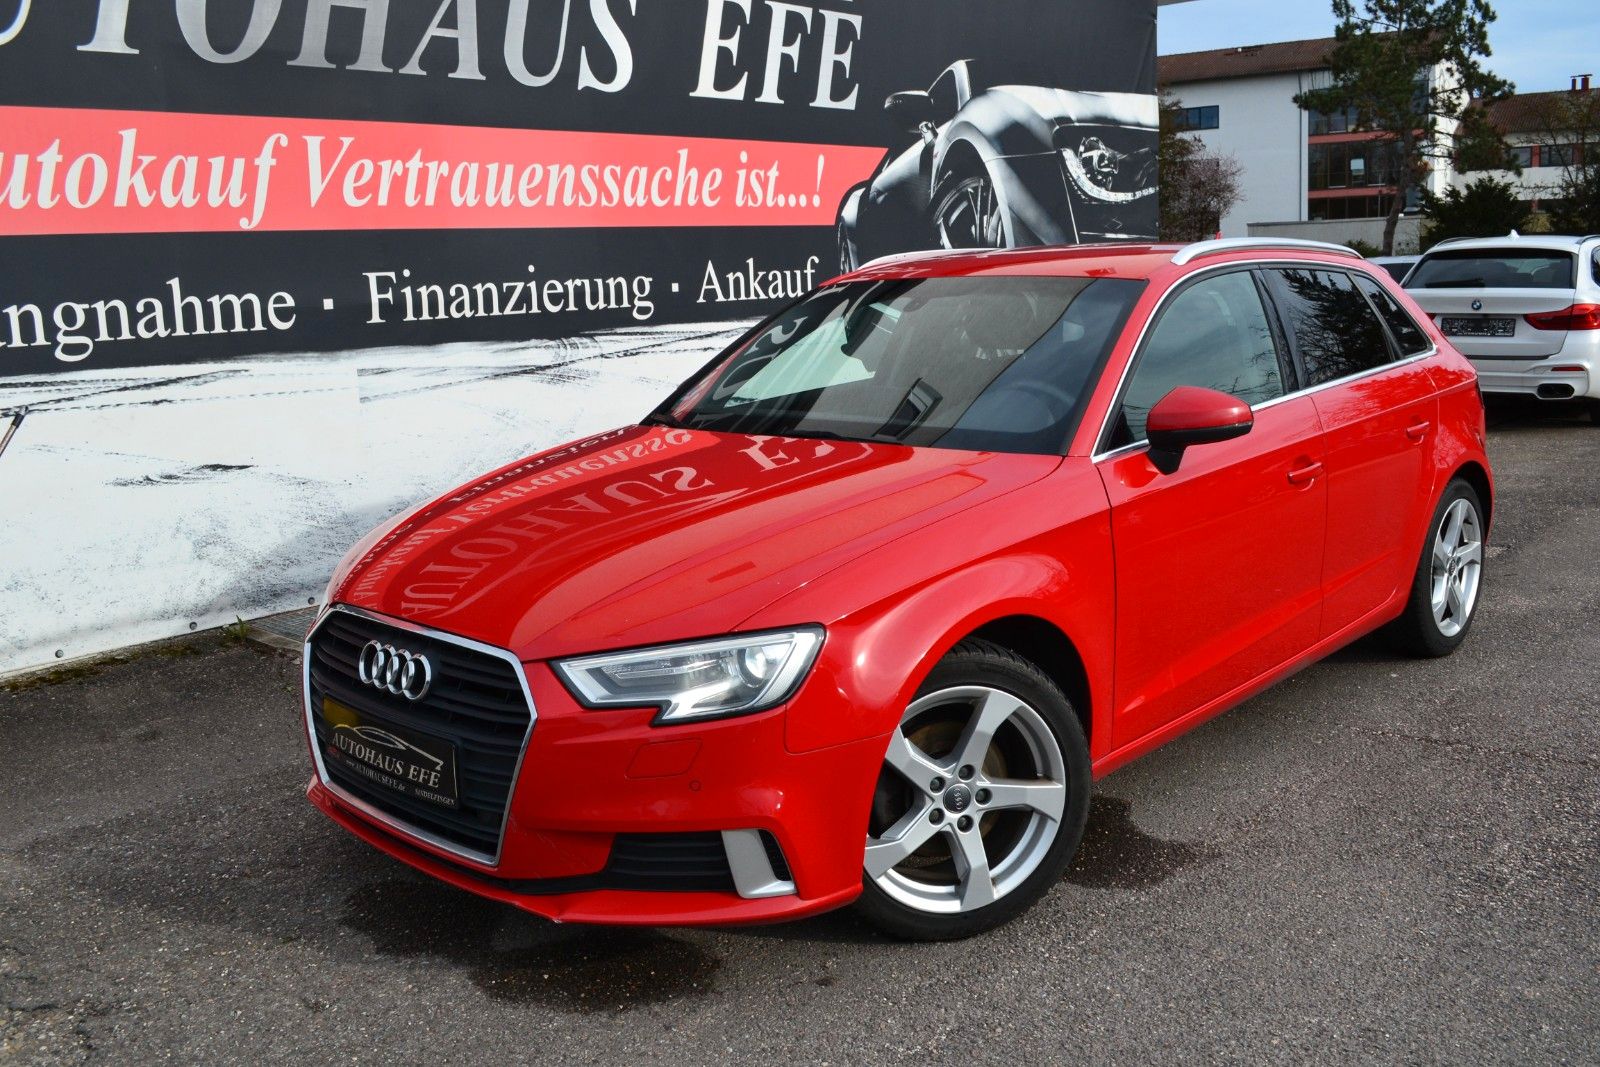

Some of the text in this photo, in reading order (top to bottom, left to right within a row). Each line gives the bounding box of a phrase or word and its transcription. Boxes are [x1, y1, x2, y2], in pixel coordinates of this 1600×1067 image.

[0, 0, 863, 111] HAUS EFE
[0, 128, 825, 230] utokauf Vertrauenssache ist...!
[0, 256, 820, 362] ngnahme Finanzierung Ankauf
[332, 732, 441, 789] AUTOHAUS EFE
